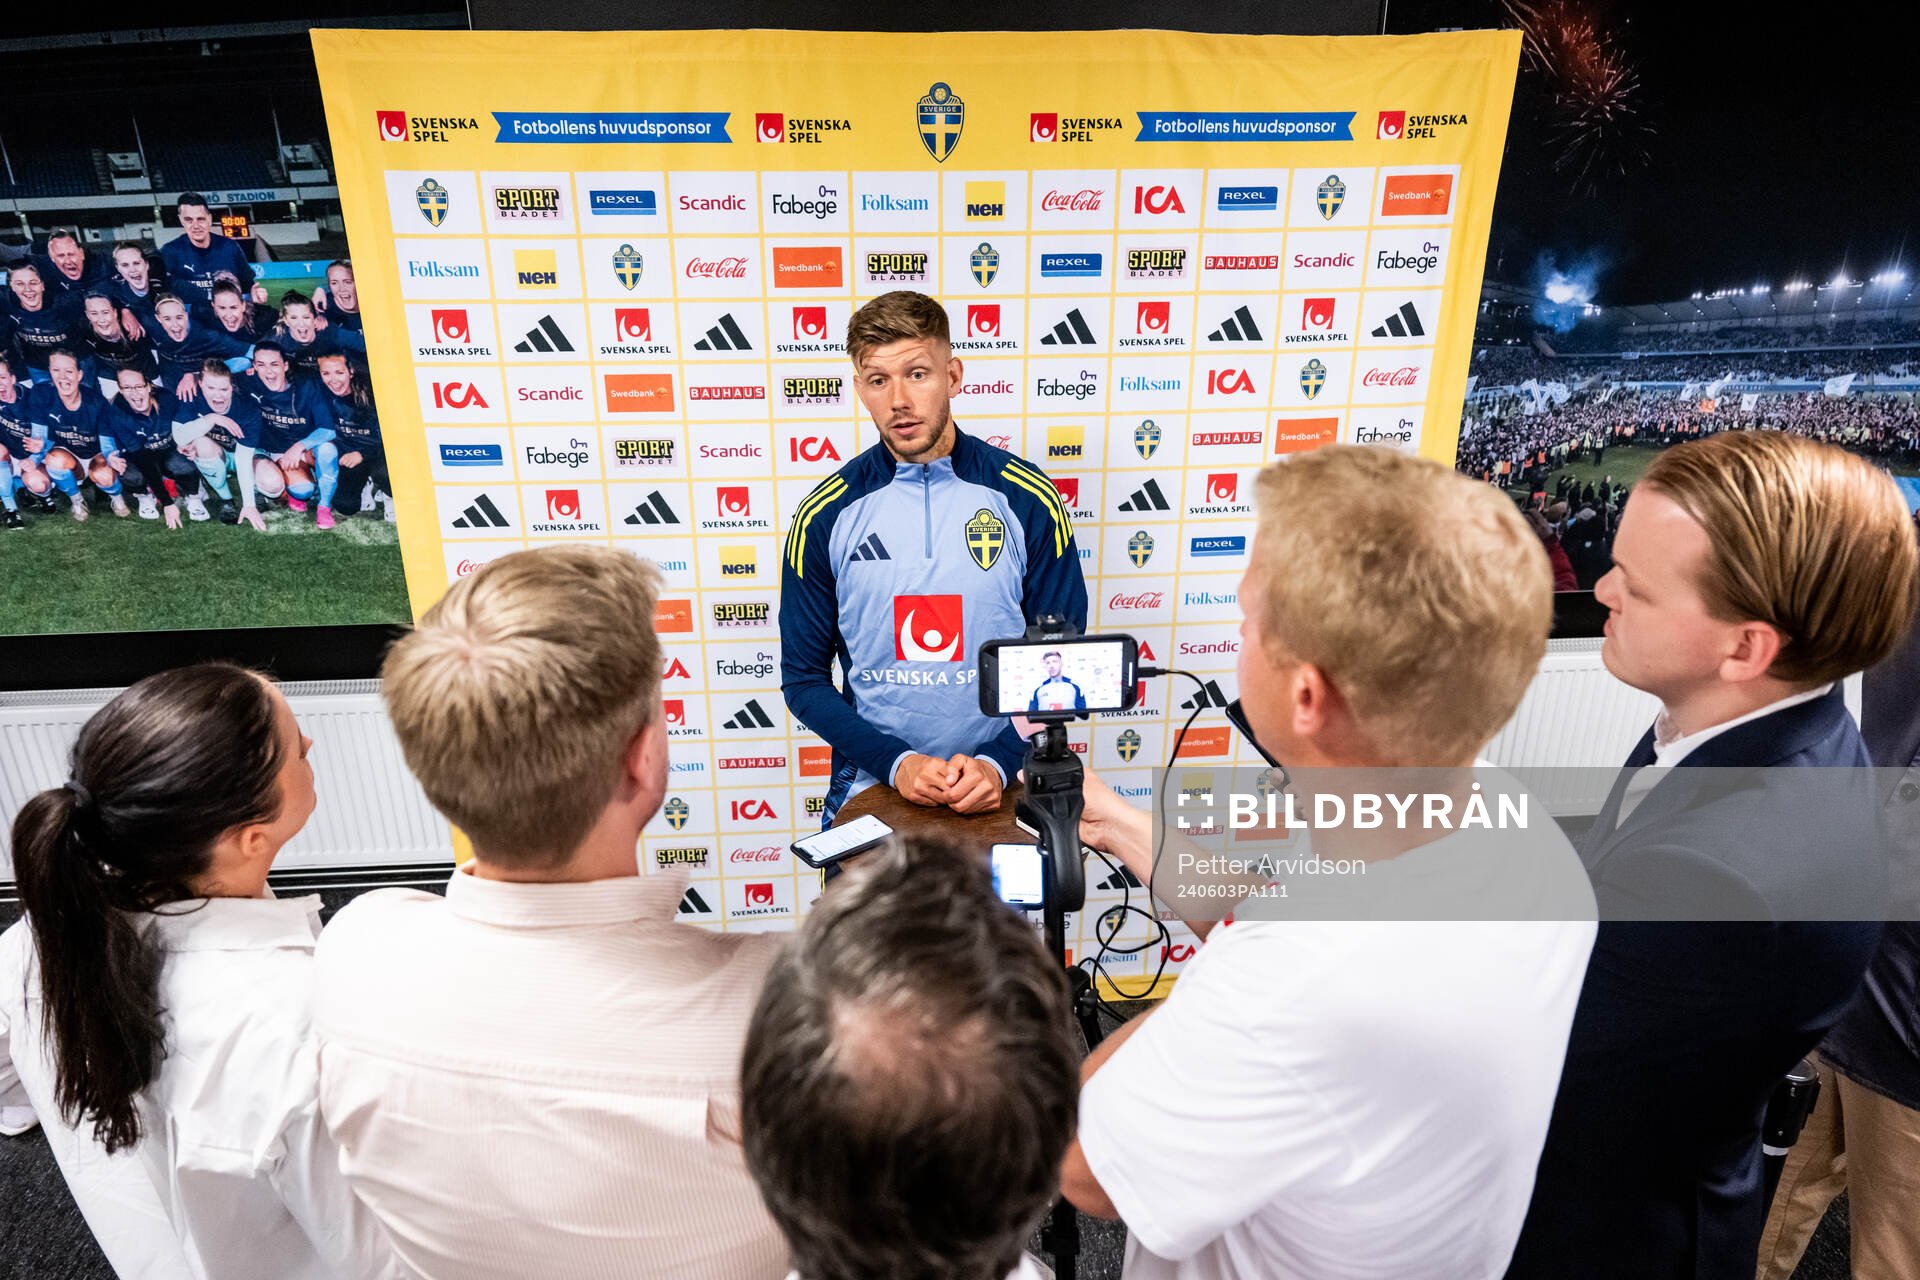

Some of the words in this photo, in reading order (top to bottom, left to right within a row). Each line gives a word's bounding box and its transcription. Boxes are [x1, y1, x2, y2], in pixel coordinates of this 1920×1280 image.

[411, 117, 479, 130] SVENSKA
[788, 119, 851, 131] SVENSKA
[1061, 118, 1122, 130] SVENSKA
[1408, 114, 1468, 127] SVENSKA
[514, 120, 596, 135] Fotbollens
[600, 120, 711, 137] huvudsponsor
[1155, 119, 1230, 134] Fotbollens
[1233, 119, 1336, 136] huvudsponsor
[1407, 127, 1436, 139] SPEL
[413, 131, 449, 142] SPEL
[789, 132, 822, 143] SPEL
[1061, 131, 1093, 142] SPEL
[227, 191, 275, 201] STADION
[495, 188, 560, 211] SPORT
[1041, 189, 1105, 211] Coca-Cola
[1134, 185, 1186, 214] ICA
[1388, 190, 1431, 200] Swedbank
[679, 195, 746, 211] Scandic
[773, 194, 837, 219] Fabege
[862, 194, 928, 211] Folksam
[222, 217, 246, 226] 90:00
[867, 253, 927, 274] SPORT
[1128, 249, 1186, 270] SPORT
[1205, 256, 1277, 269] BAUHAUS
[1294, 252, 1355, 268] Scandic
[1377, 251, 1438, 274] Fabege
[408, 261, 479, 278] Folksam
[686, 257, 750, 278] Coca-Cola
[779, 263, 823, 272] Swedbank
[1119, 338, 1161, 346] SVENSKA
[1164, 337, 1185, 345] SPEL
[1285, 334, 1325, 343] SVENSKA
[1328, 333, 1348, 341] SPEL
[419, 348, 466, 356] SVENSKA
[468, 348, 492, 356] SPEL
[600, 346, 645, 354] SVENSKA
[648, 345, 671, 353] SPEL
[776, 344, 820, 353] SVENSKA
[823, 344, 847, 352] SPEL
[950, 341, 993, 350] SVENSKA
[1208, 368, 1256, 395] ICA
[1362, 366, 1420, 387] Coca-Cola
[784, 378, 842, 397] SPORT
[1038, 379, 1096, 400] Fabege
[1120, 376, 1180, 391] Folksam
[432, 382, 490, 409] ICA
[518, 387, 584, 401] Scandic
[610, 389, 655, 398] Swedbank
[690, 387, 765, 399] BAUHAUS
[1193, 432, 1262, 445] BAUHAUS
[1280, 432, 1320, 441] Swedbank
[615, 440, 674, 459] SPORT
[700, 443, 762, 458] Scandic
[790, 436, 841, 462] ICA
[526, 447, 588, 468] Fabege
[1189, 506, 1228, 514] SVENSKA
[533, 523, 576, 532] SVENSKA
[578, 523, 600, 531] SPEL
[702, 520, 744, 529] SVENSKA
[747, 520, 769, 528] SPEL
[1109, 592, 1165, 610] Coca-Cola
[713, 603, 769, 620] SPORT
[1180, 641, 1239, 654] Scandic
[717, 659, 774, 678] Fabege
[861, 669, 949, 686] SVENSKA
[955, 669, 977, 685] SP
[1181, 738, 1214, 746] wedbank
[668, 760, 704, 772] ksam
[719, 758, 785, 769] BAUHAUS
[1113, 785, 1152, 797] lksam
[731, 800, 778, 821] ICA
[656, 848, 708, 865] SPORT
[730, 846, 784, 863] Coca-Cola
[731, 909, 769, 917] SVENSKA
